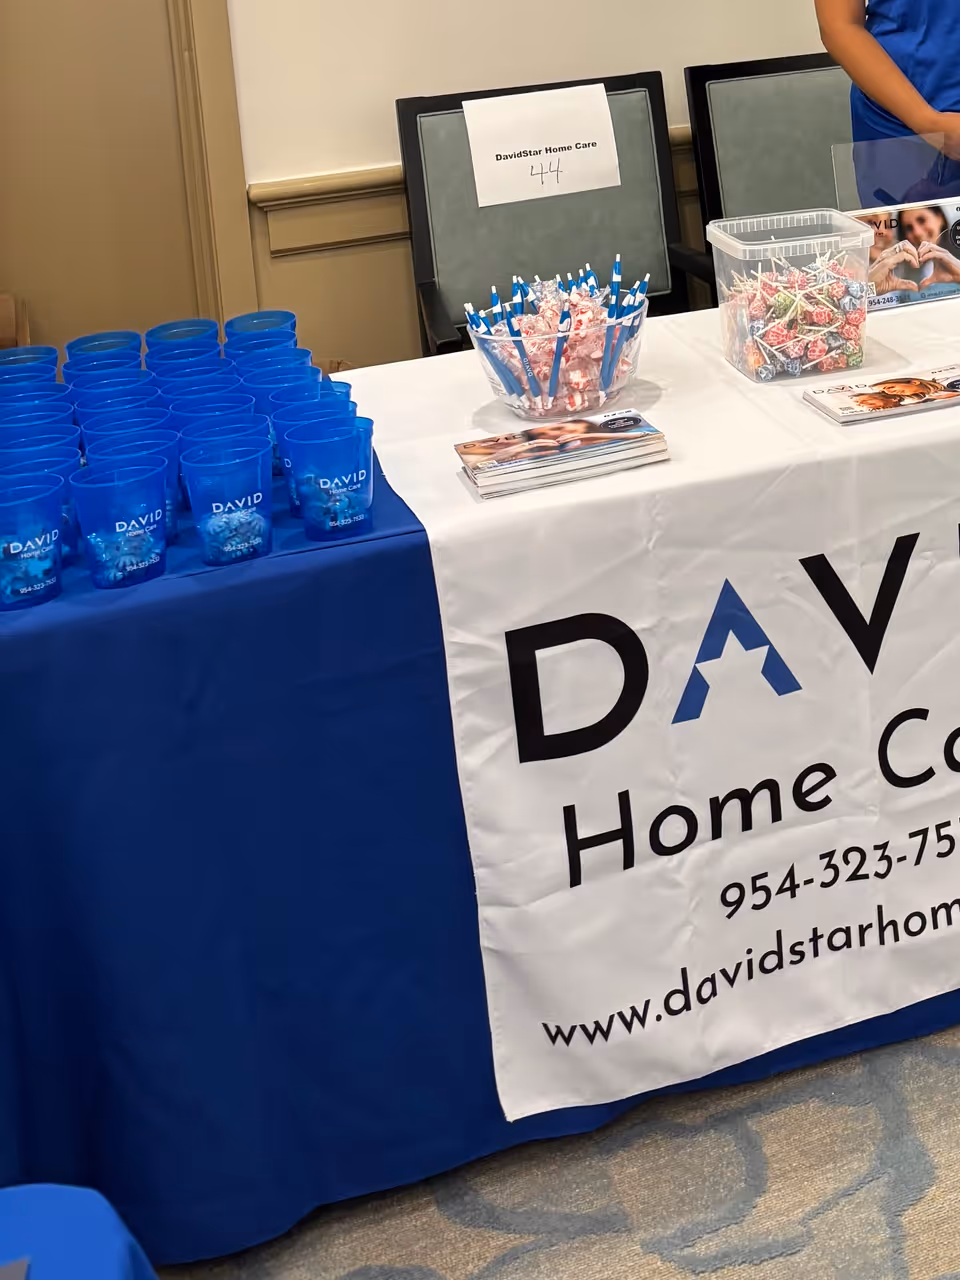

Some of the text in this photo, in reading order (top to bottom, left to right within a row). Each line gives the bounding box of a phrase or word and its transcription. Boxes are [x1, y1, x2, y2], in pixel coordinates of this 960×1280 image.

[495, 141, 598, 162] DavidStar Home Care
[530, 157, 564, 185] 44
[873, 218, 898, 230] VID
[319, 469, 367, 489] DAVID
[329, 487, 348, 495] Home
[211, 492, 263, 513] DAVID
[115, 509, 163, 533] DAVID
[9, 528, 59, 554] DAVID
[562, 758, 837, 887] Home
